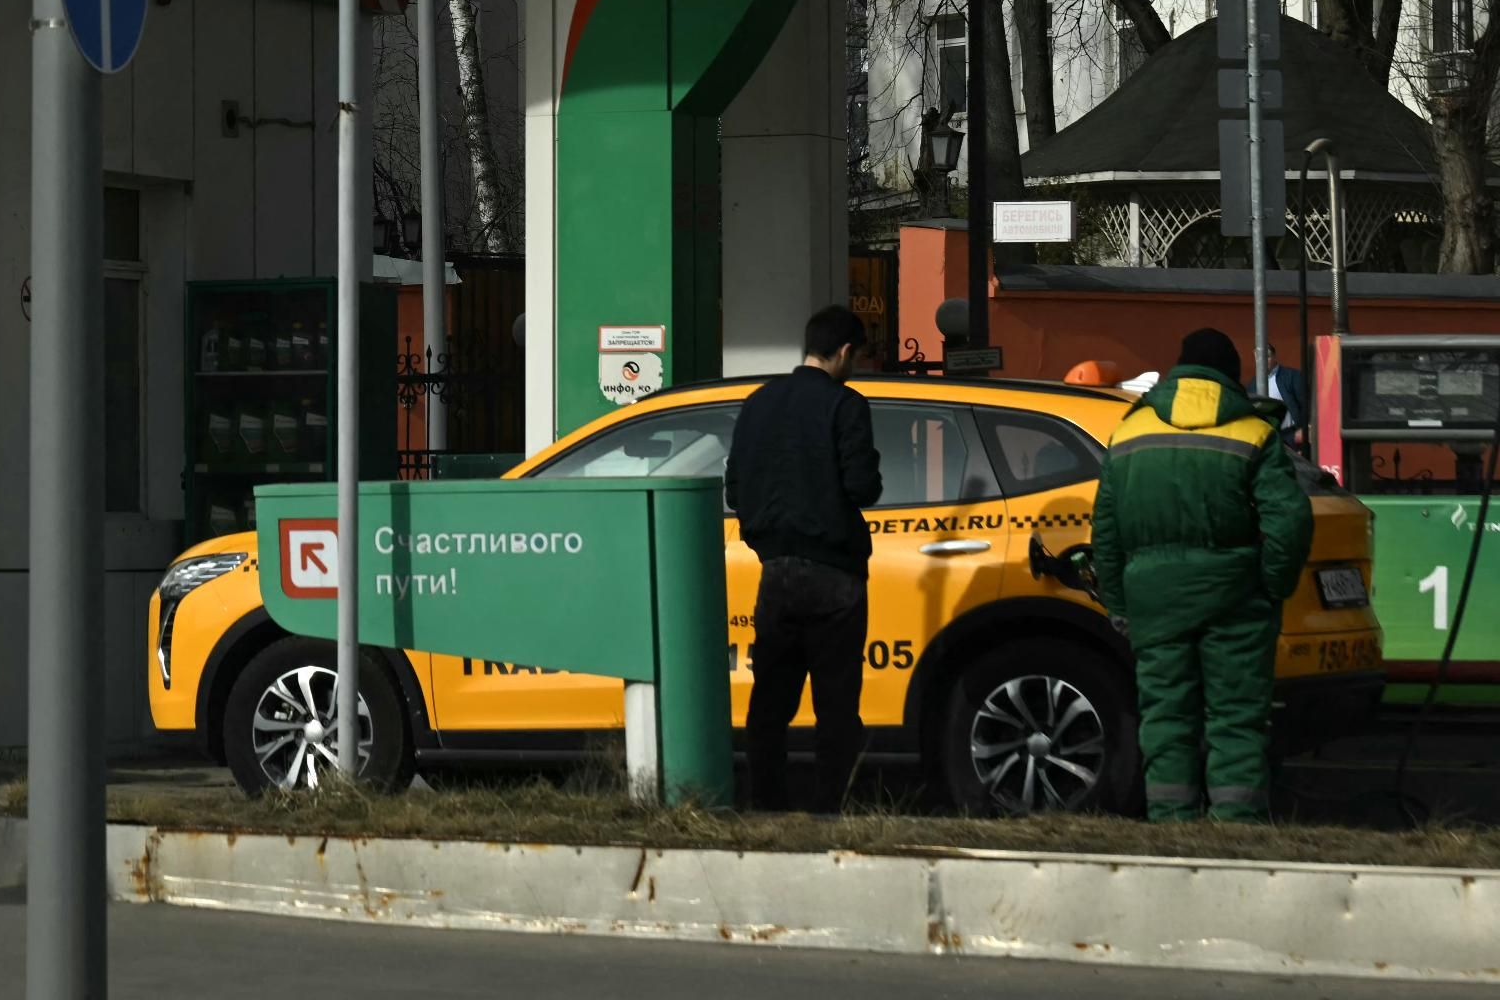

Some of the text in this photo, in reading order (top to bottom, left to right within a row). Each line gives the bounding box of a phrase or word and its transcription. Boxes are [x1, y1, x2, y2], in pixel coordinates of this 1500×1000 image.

[1002, 210, 1063, 222] БЕРЕГИСЬ
[374, 526, 584, 554] Счастливого
[375, 568, 457, 600] пути!
[1418, 565, 1449, 630] 1
